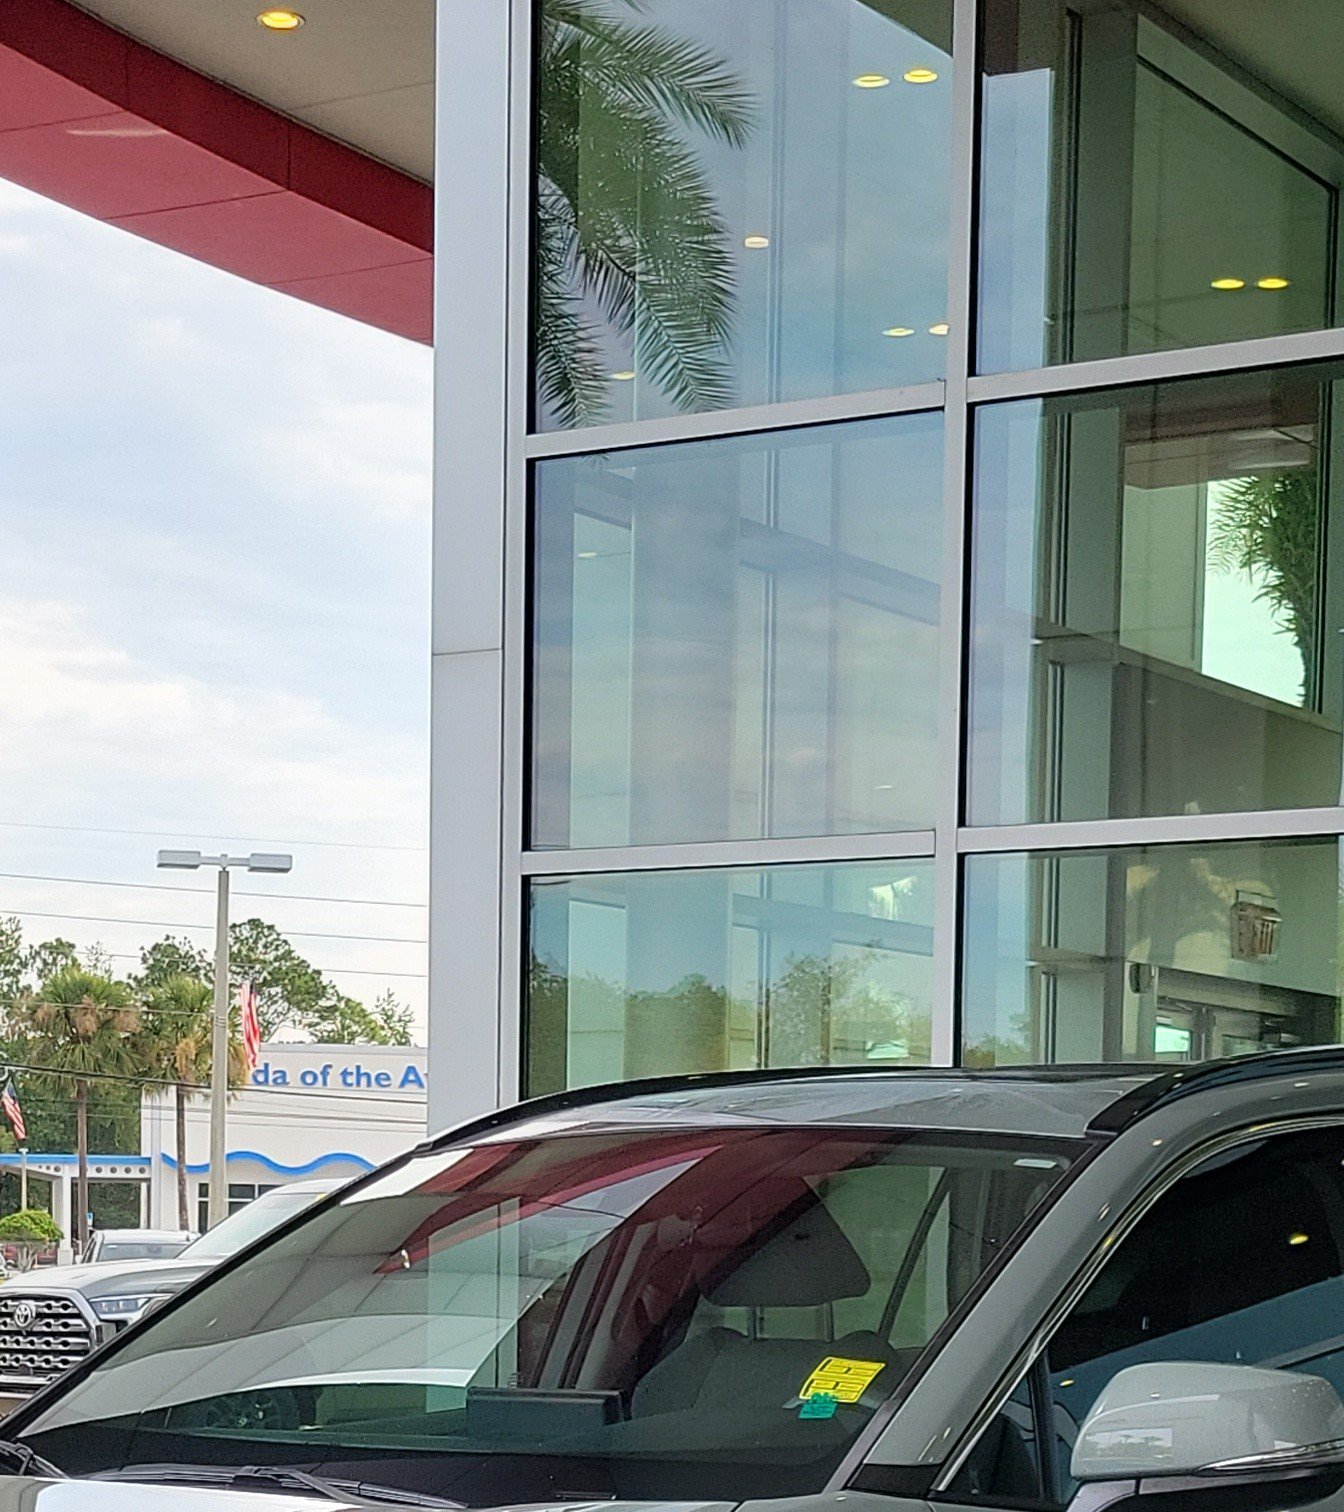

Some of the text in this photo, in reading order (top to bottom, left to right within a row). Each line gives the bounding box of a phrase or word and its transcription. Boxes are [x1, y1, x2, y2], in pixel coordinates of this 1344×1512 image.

[251, 1062, 427, 1090] da of the A
